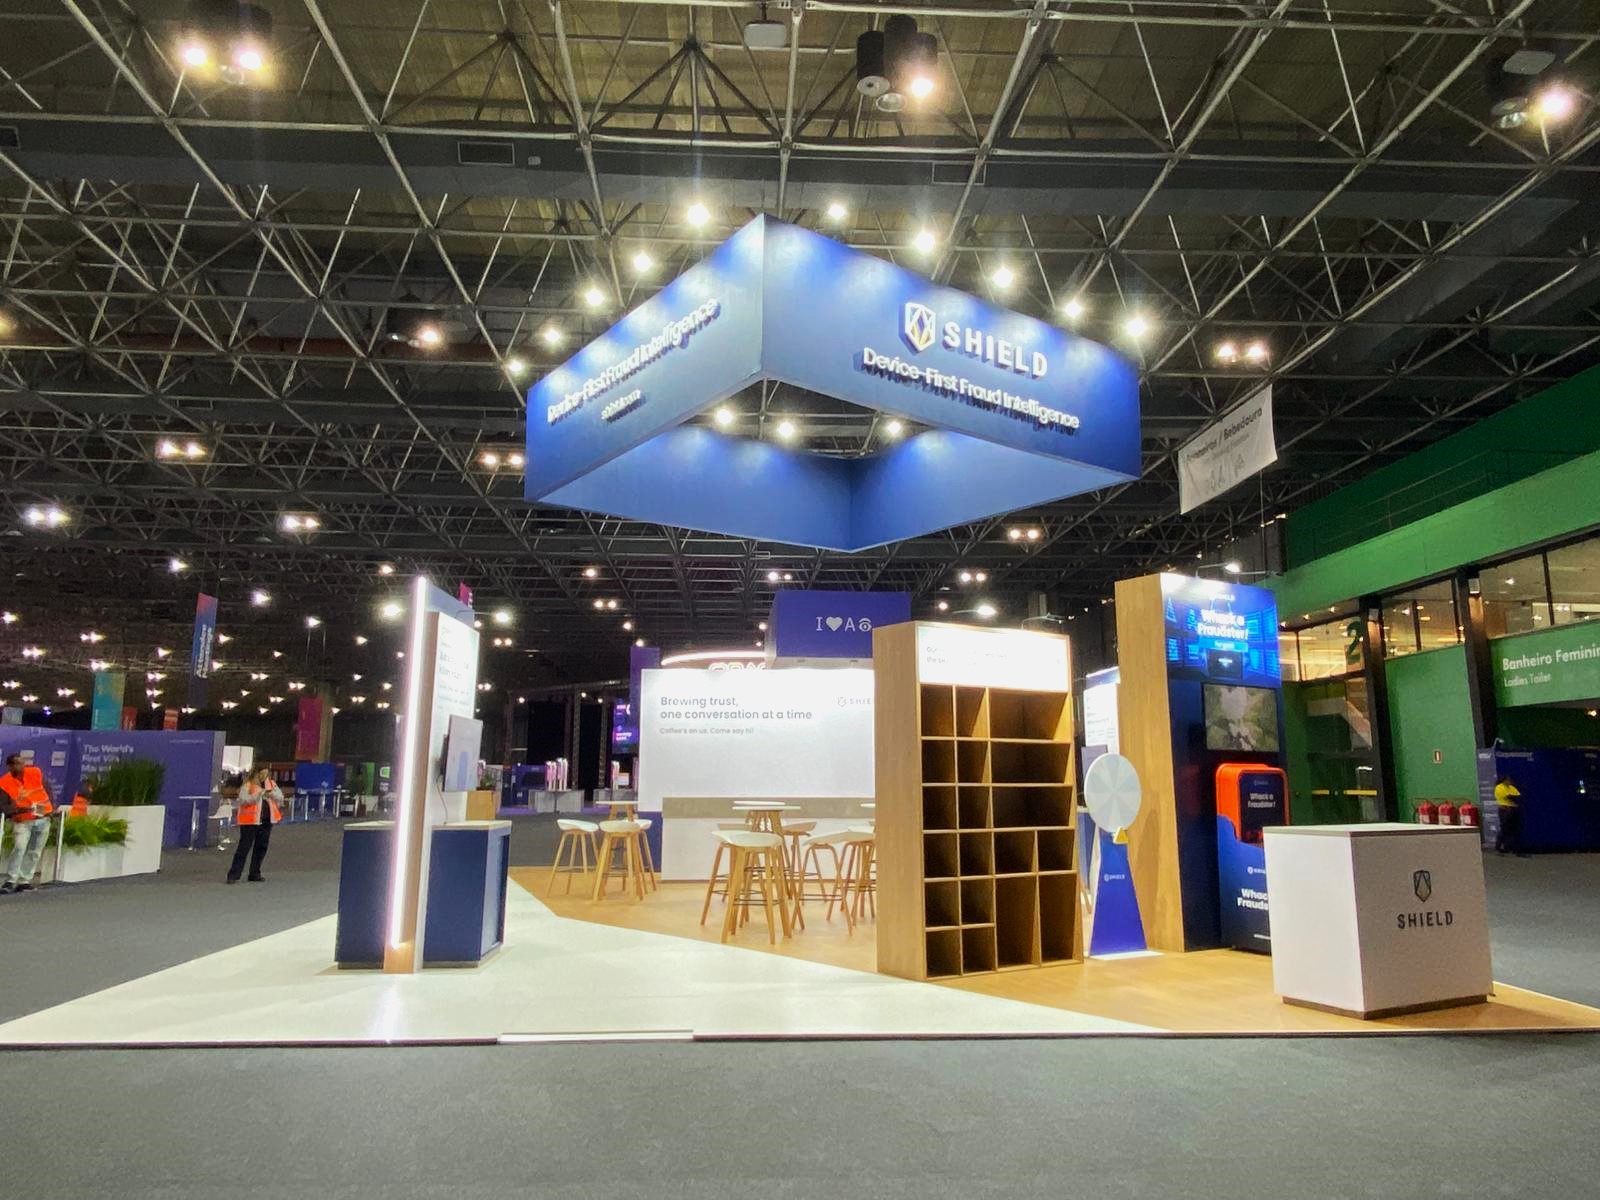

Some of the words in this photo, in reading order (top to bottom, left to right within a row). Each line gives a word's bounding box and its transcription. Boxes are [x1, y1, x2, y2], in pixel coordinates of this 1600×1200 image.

[639, 297, 720, 365] Intelligence
[943, 320, 1049, 378] SHIELD
[863, 346, 959, 391] Device-First
[959, 378, 1003, 406] Fraud
[1003, 391, 1080, 429] Intelligence
[1200, 609, 1236, 625] Whack
[1236, 615, 1245, 626] a
[1197, 622, 1249, 640] Fraudster!
[1502, 652, 1553, 671] Banheiro
[660, 696, 707, 709] Brewing
[709, 696, 739, 707] trust,
[849, 697, 871, 705] SHIE
[660, 711, 682, 720] one
[684, 709, 759, 720] conversation
[761, 709, 775, 720] at
[776, 711, 784, 720] a
[786, 709, 813, 720] time
[659, 727, 688, 735] Coffee's
[709, 727, 727, 735] Come
[84, 744, 100, 753] The
[101, 744, 134, 753] World's
[1241, 887, 1268, 901] Whac
[1396, 910, 1454, 929] SHIELD
